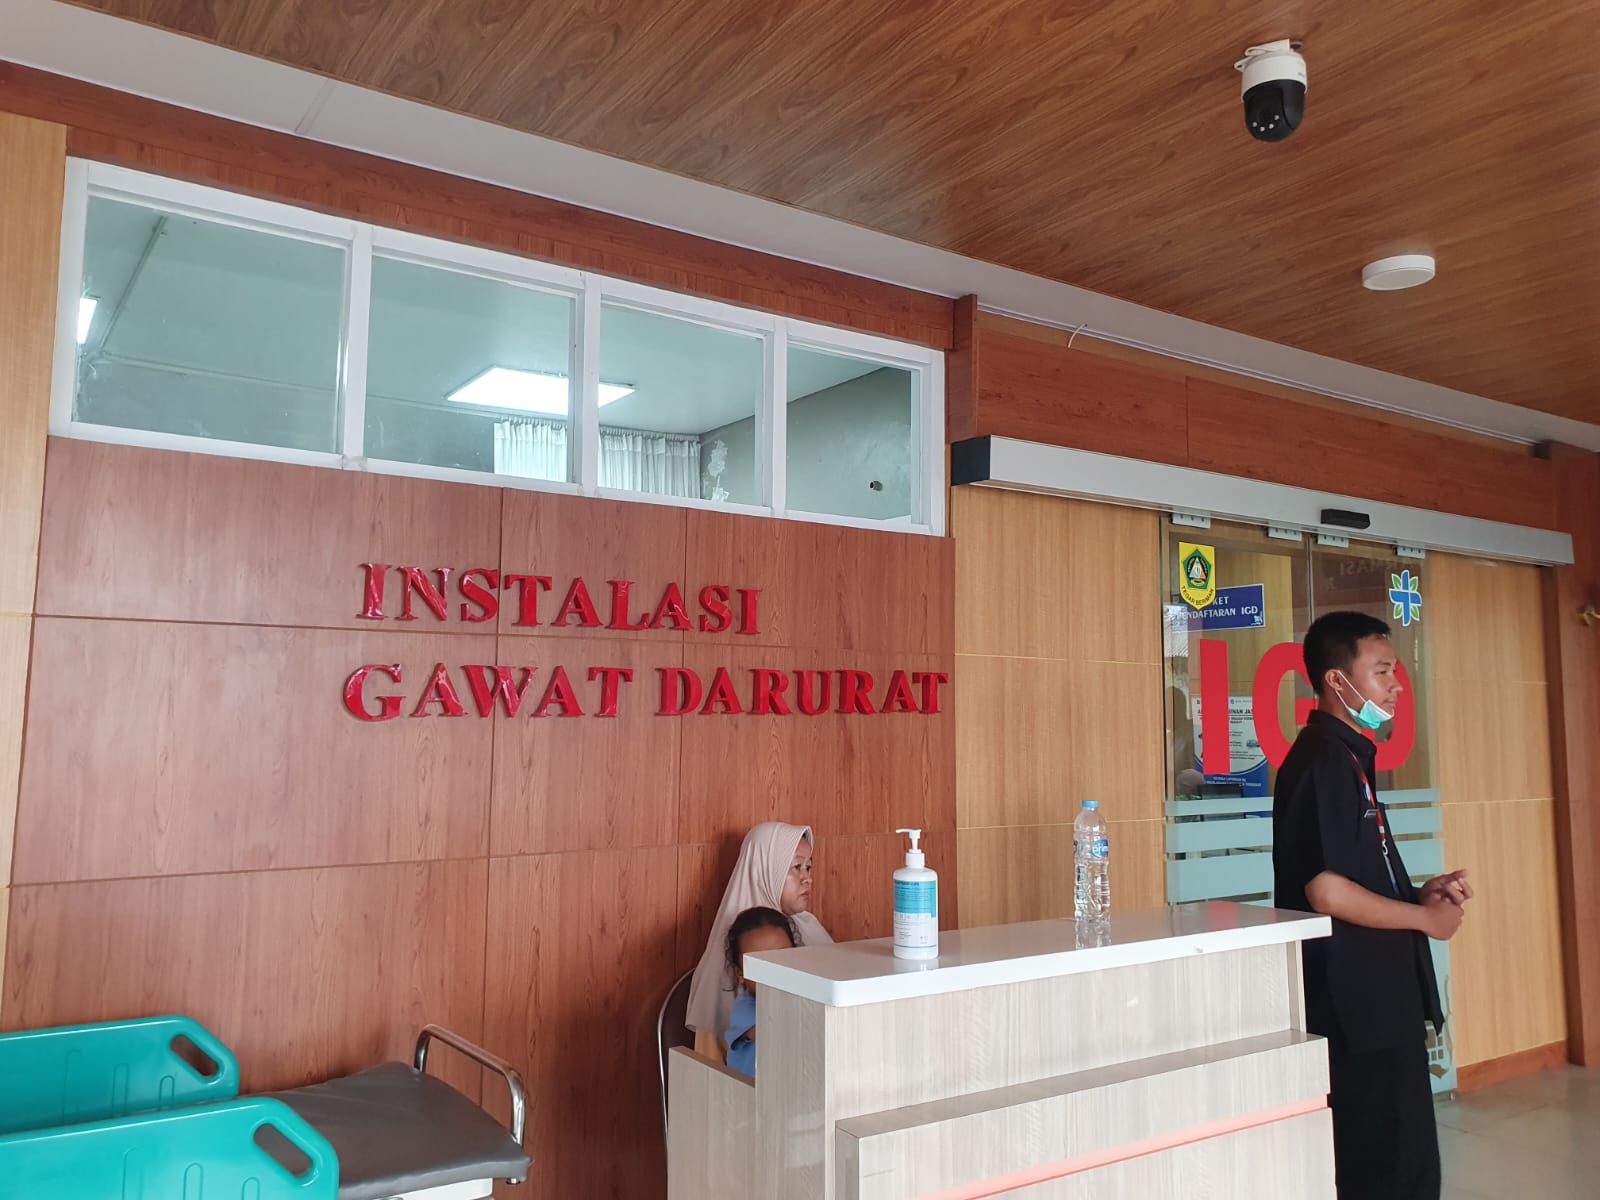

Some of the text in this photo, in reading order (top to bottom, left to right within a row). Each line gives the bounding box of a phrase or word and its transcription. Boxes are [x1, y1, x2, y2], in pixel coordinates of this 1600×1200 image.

[357, 563, 762, 635] INSTALASI
[1181, 585, 1195, 604] TEGAR
[1241, 605, 1258, 615] IGD
[342, 662, 949, 721] GAWAT DARURAT
